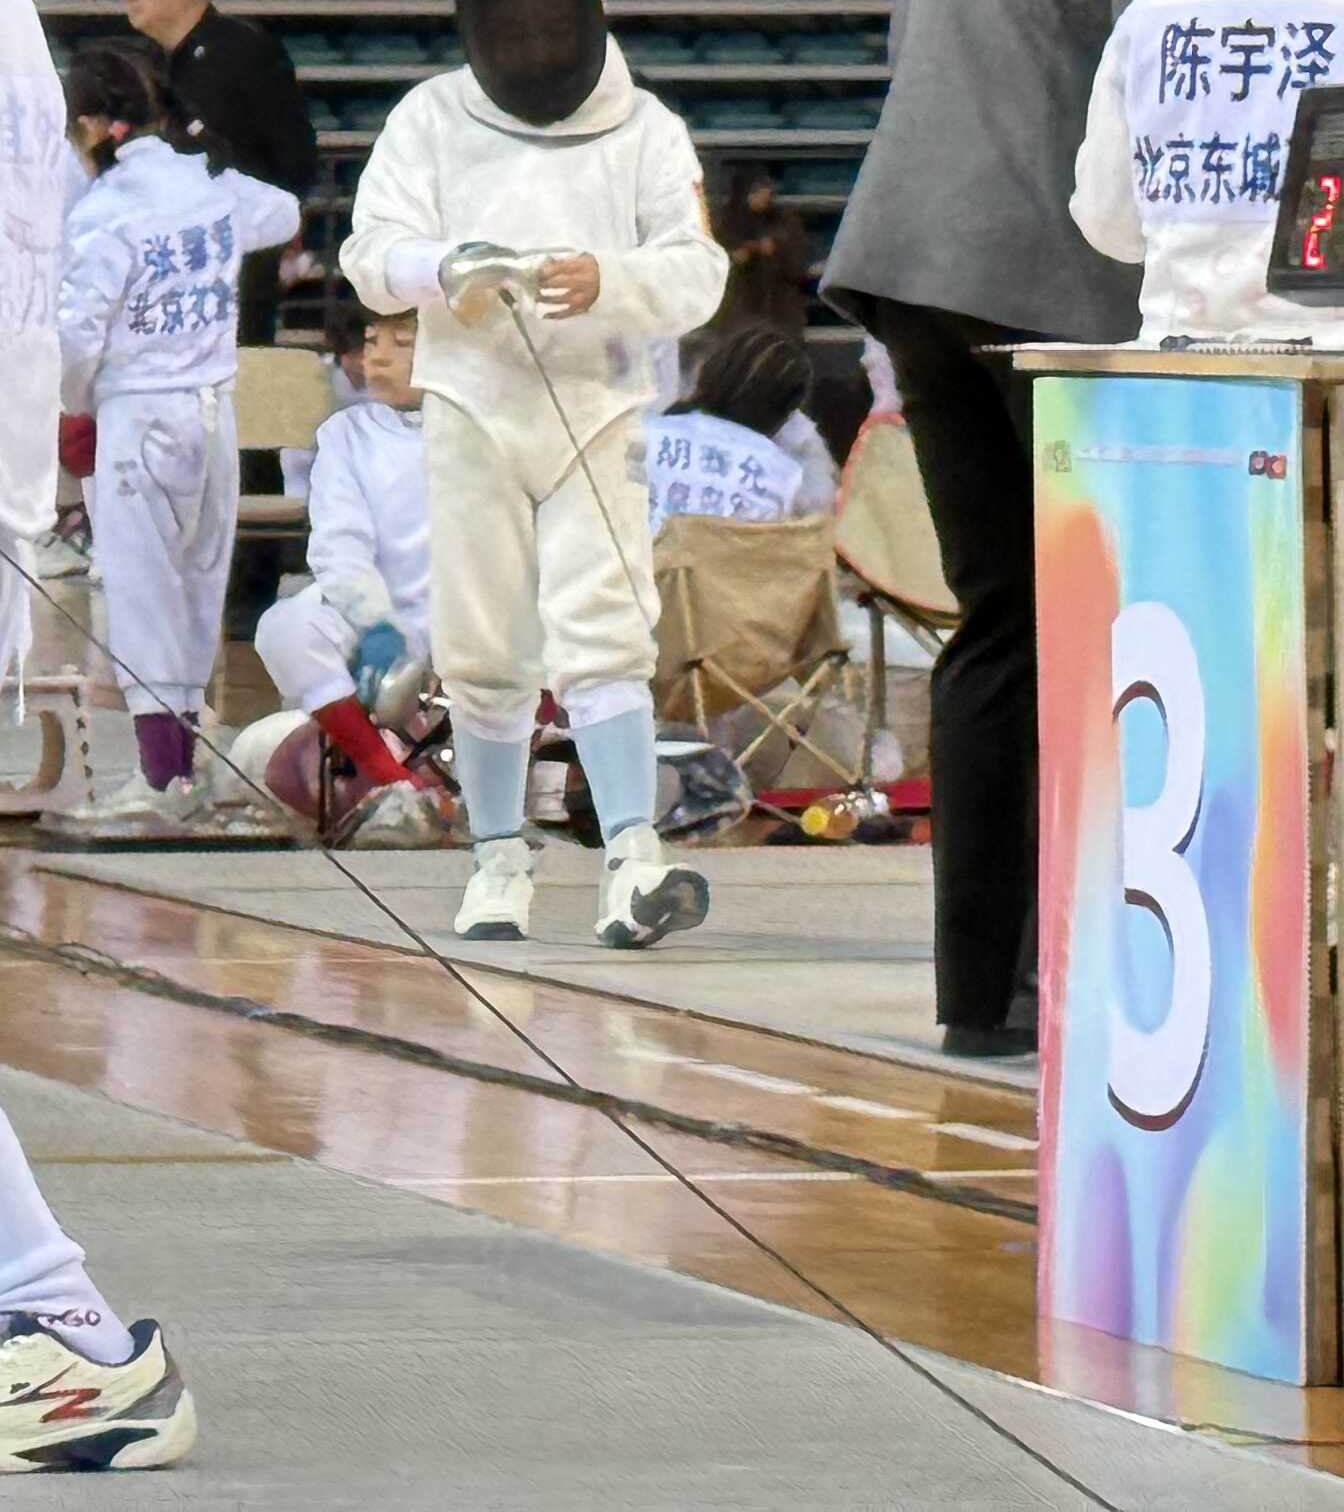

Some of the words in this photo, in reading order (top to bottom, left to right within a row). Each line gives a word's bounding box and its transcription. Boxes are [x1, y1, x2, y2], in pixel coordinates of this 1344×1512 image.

[1158, 16, 1336, 104] 陈宇泽
[1106, 600, 1212, 1132] 3
